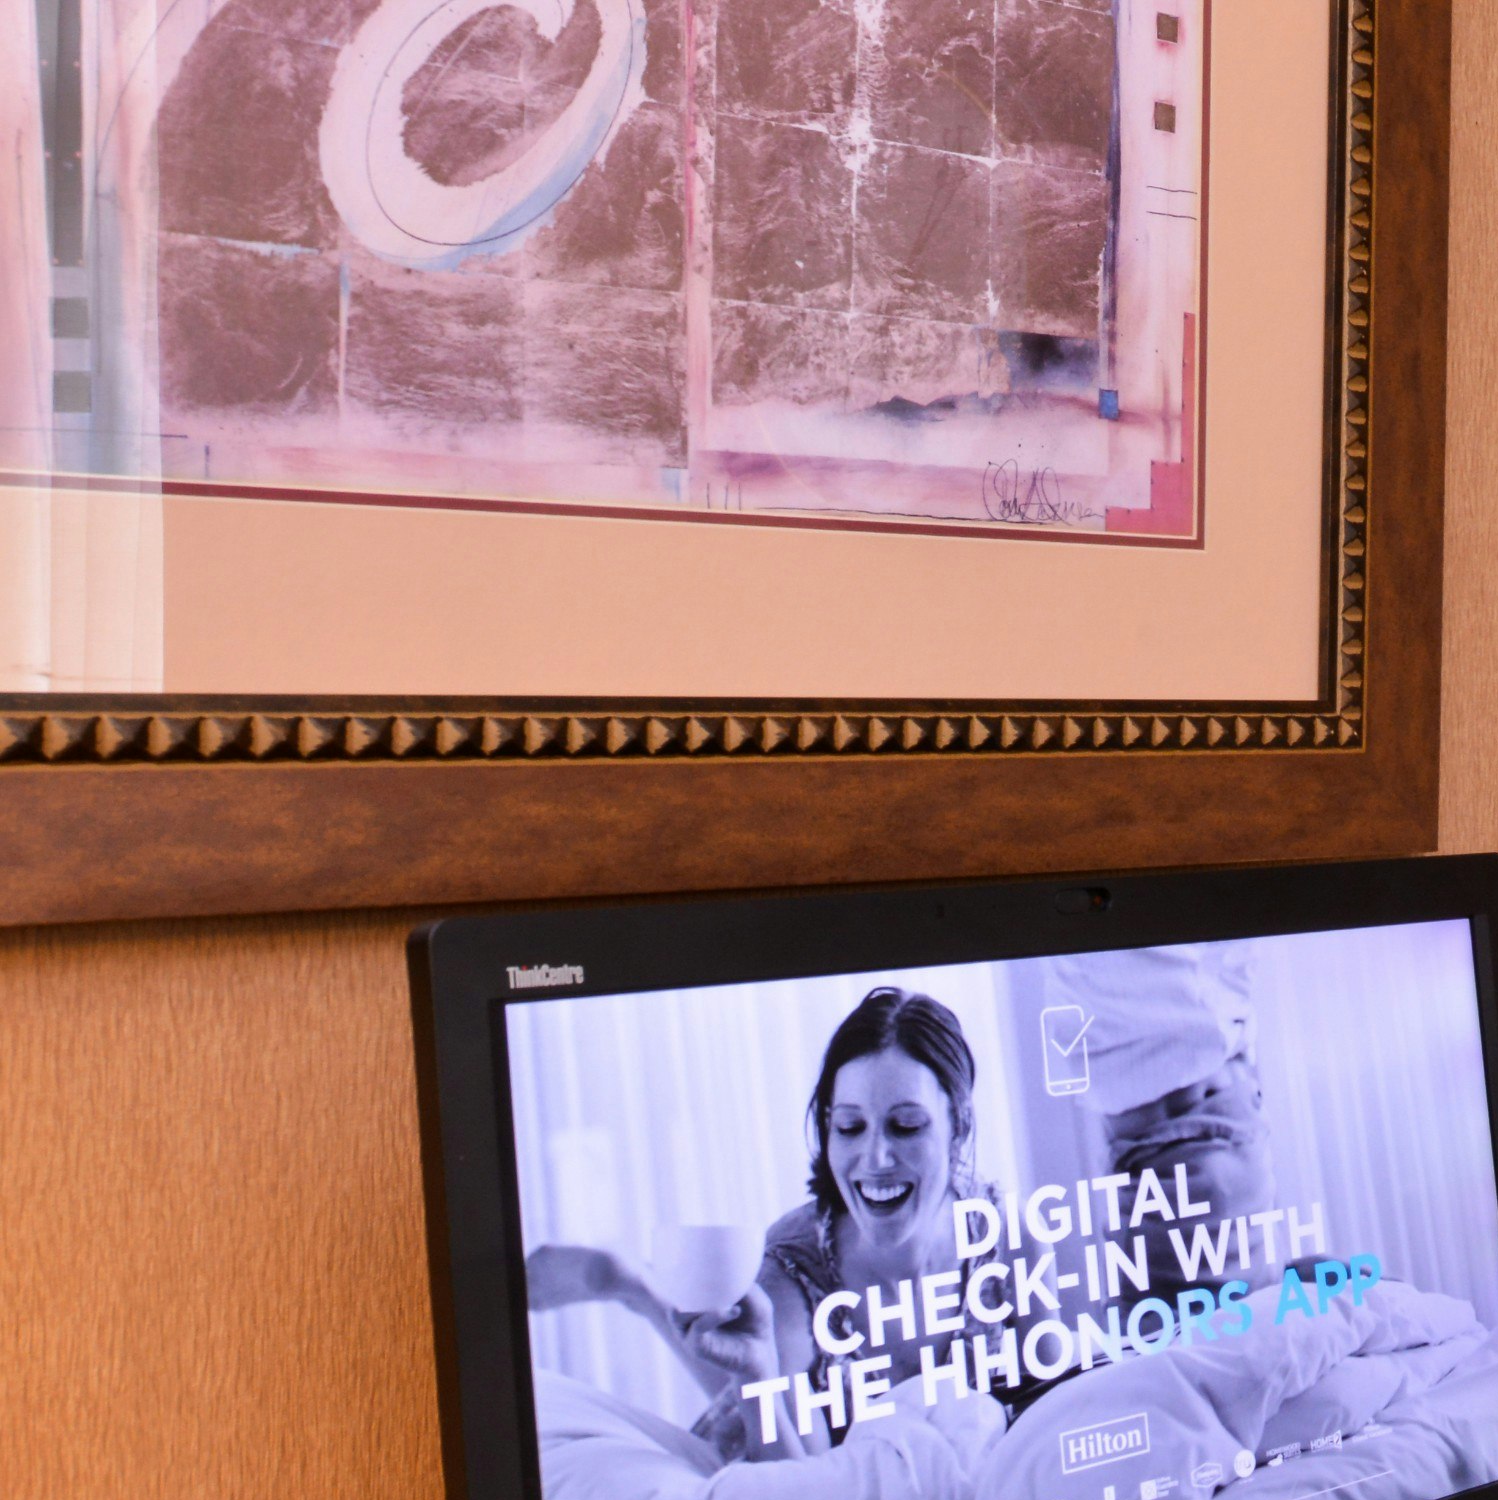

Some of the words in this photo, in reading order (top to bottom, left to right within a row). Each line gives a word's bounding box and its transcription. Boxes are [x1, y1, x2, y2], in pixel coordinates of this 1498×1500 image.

[506, 963, 584, 989] ThinkCentre
[953, 1163, 1211, 1259] DIGITAL
[813, 1235, 1150, 1355] CHECK-IN
[1169, 1202, 1327, 1281] WITH
[741, 1354, 896, 1444] THE
[920, 1280, 1253, 1407] HHONORS
[1274, 1252, 1382, 1325] APP
[1068, 1428, 1142, 1464] Hilton
